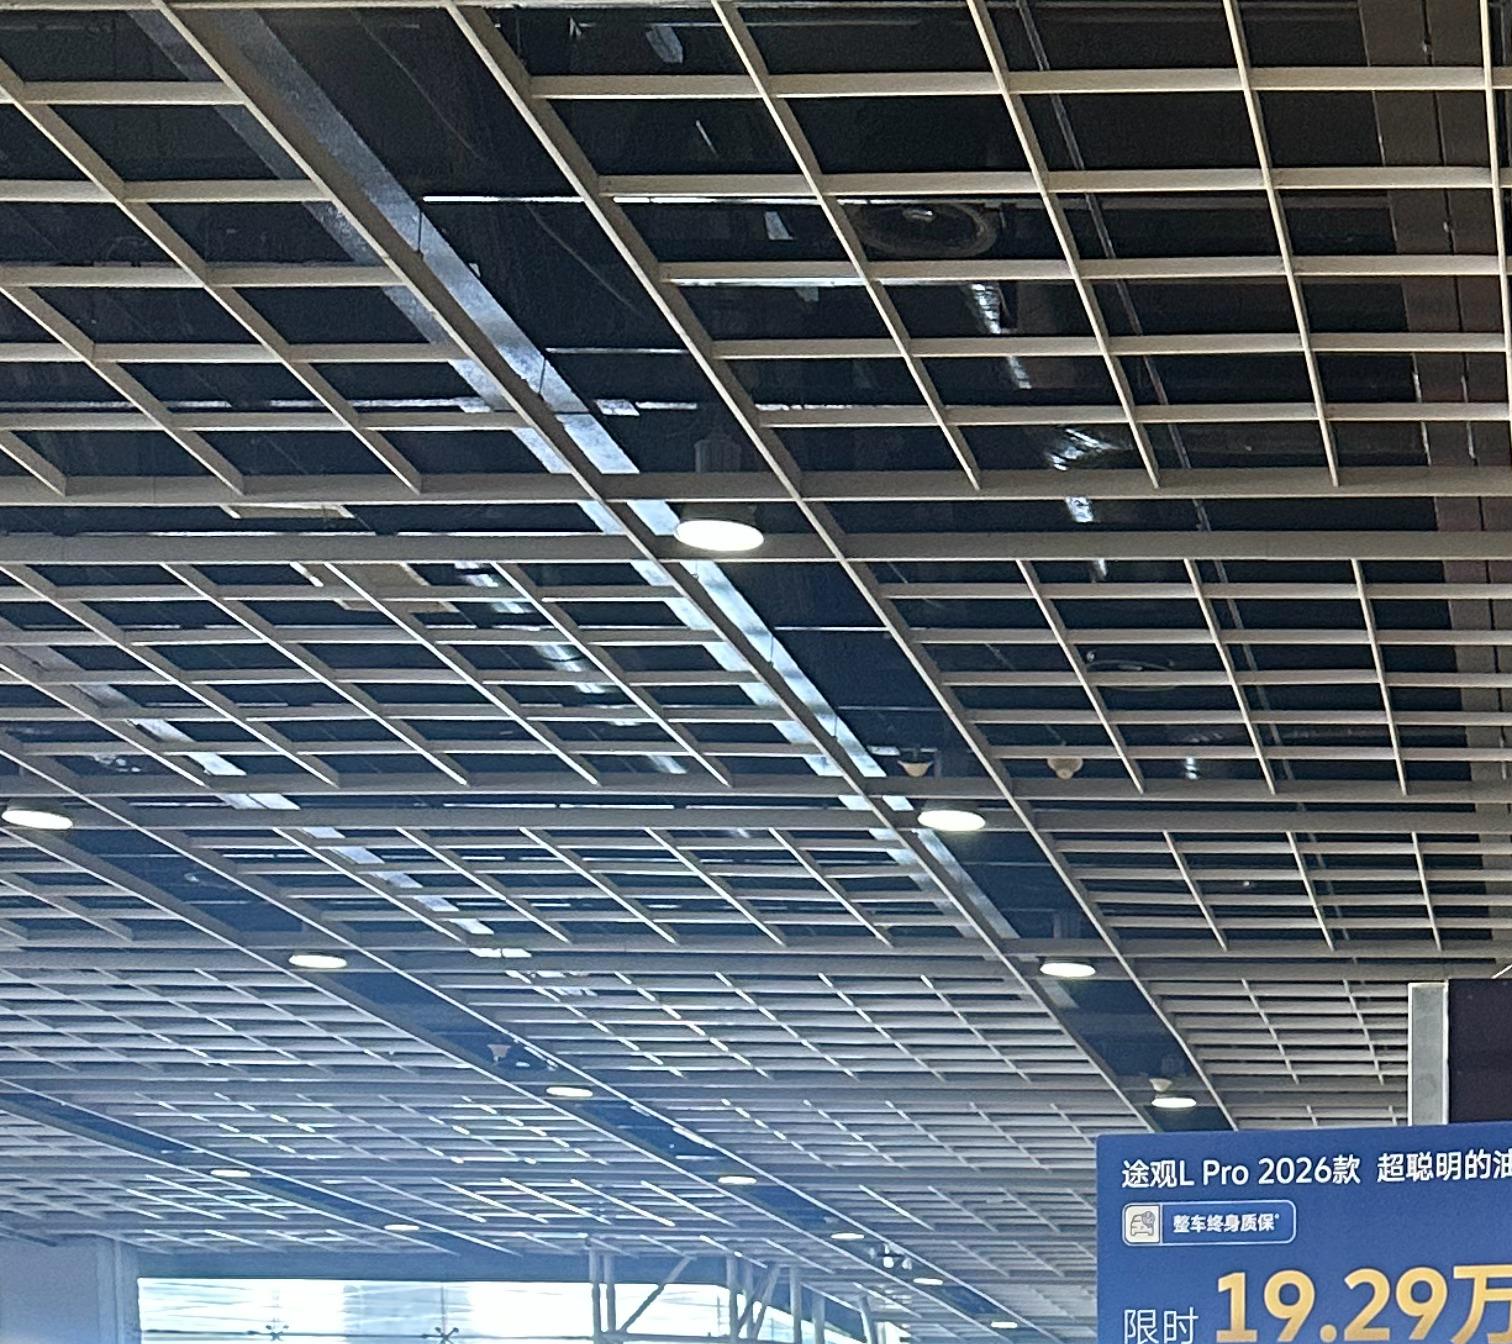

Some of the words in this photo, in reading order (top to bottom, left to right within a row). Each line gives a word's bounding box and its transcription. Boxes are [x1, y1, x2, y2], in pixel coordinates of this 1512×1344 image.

[1122, 1158, 1195, 1189] 途观L
[1203, 1158, 1249, 1187] Pro
[1258, 1153, 1361, 1186] 2026款
